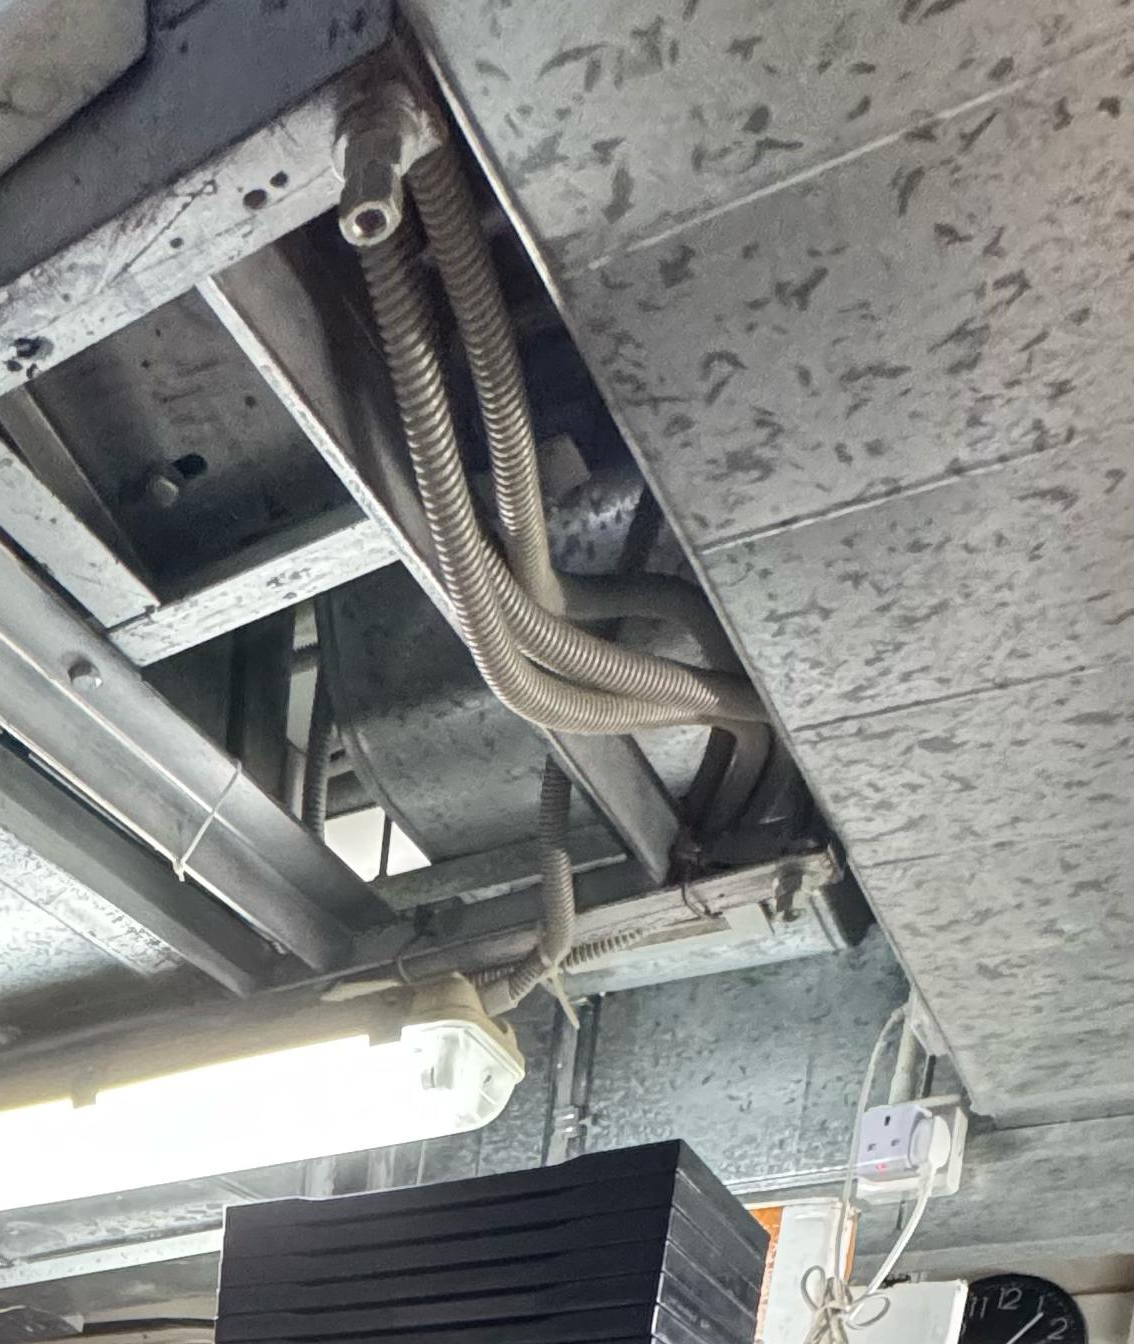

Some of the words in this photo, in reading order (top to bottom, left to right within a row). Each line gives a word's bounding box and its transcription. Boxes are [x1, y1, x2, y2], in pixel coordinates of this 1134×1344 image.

[969, 1296, 988, 1319] 11
[997, 1286, 1023, 1311] 12
[1036, 1295, 1045, 1313] 1
[1046, 1316, 1068, 1341] 2
